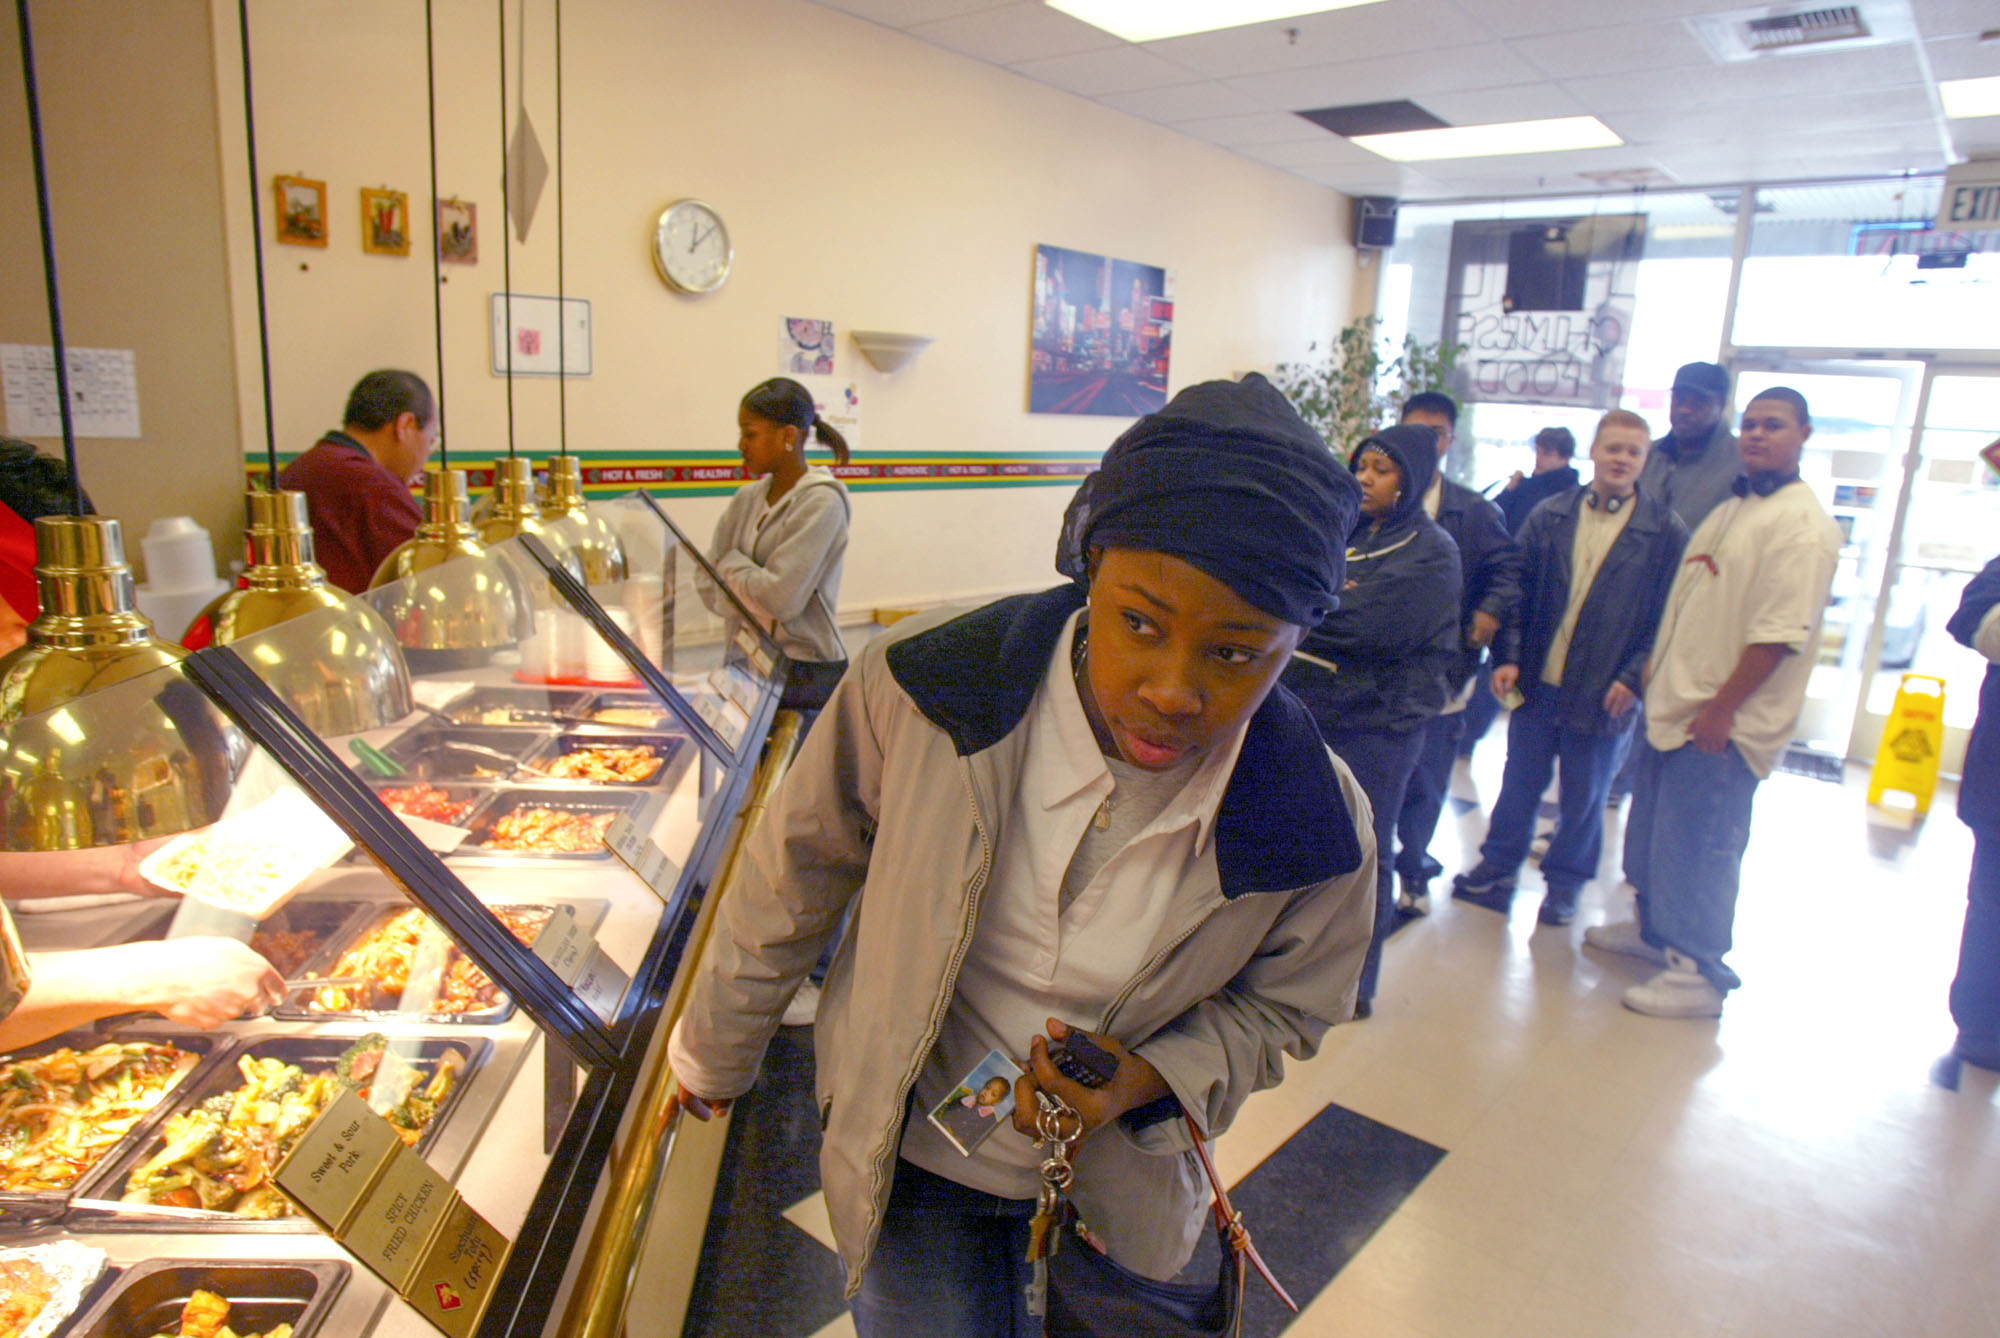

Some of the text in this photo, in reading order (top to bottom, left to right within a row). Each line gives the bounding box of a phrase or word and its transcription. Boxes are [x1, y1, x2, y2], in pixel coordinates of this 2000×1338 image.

[602, 468, 663, 481] HOT & FRESH
[693, 468, 733, 479] HEALTHY
[311, 1119, 361, 1183] Sweet & Sour
[338, 1151, 360, 1174] Pork
[385, 1191, 408, 1225] SPICY
[382, 1179, 434, 1262] FRIED CHICKEN
[464, 1236, 482, 1258] Tofu
